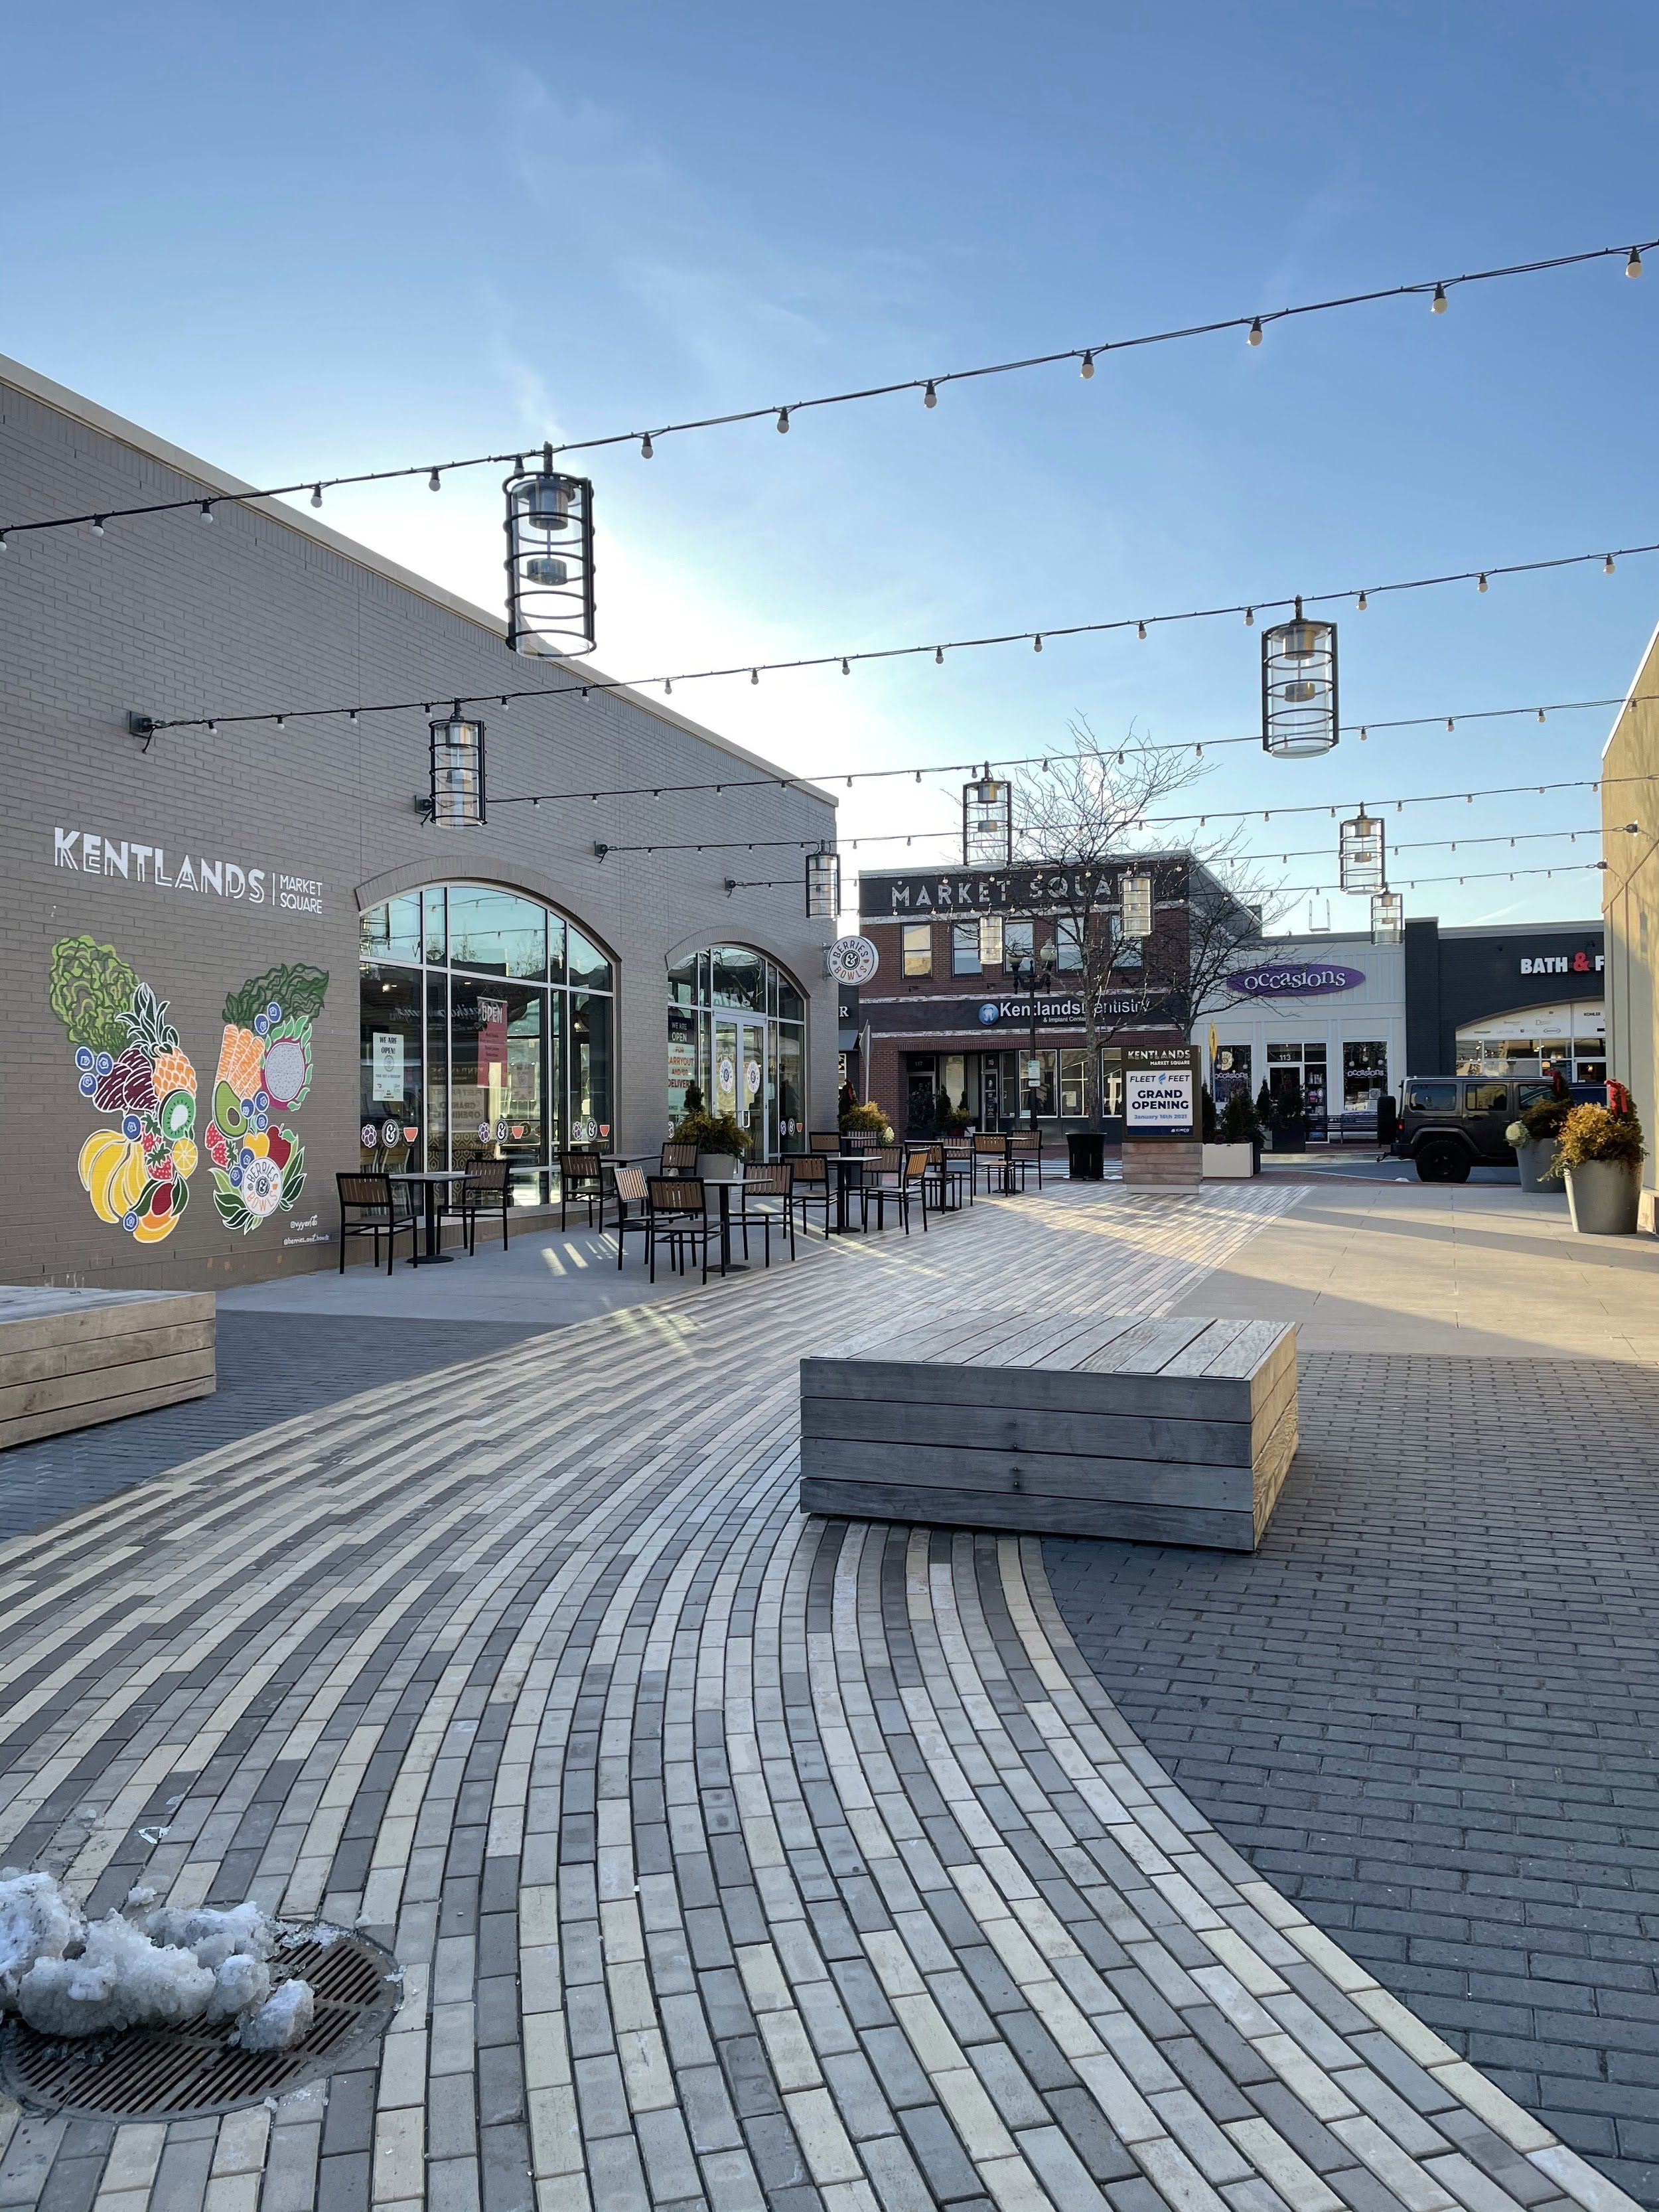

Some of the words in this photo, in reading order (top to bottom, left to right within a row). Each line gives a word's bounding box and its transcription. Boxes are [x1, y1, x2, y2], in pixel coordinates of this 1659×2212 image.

[54, 827, 265, 904] KENTLANDS
[280, 874, 323, 897] MARKET
[892, 880, 1011, 907] MARKET
[1029, 871, 1151, 899] SQUA
[280, 893, 323, 915] SQUARE
[833, 940, 869, 958] BERRIES
[845, 953, 857, 967] &
[1520, 956, 1568, 974] BATH
[1573, 952, 1590, 972] &
[834, 966, 867, 980] BOWLS
[1244, 970, 1346, 990] occasions
[482, 1001, 502, 1023] OPEN
[672, 1031, 687, 1042] OPEN
[668, 1057, 693, 1067] ARRYOUT
[1128, 1049, 1191, 1060] KENTLANDS
[1347, 1067, 1384, 1076] occasions
[668, 1078, 691, 1088] DELIVER
[1137, 1090, 1183, 1098] GRAND
[1131, 1100, 1189, 1110] OPENING
[247, 1161, 278, 1183] BERRIES
[258, 1180, 267, 1194] &
[247, 1191, 277, 1211] BOWLS
